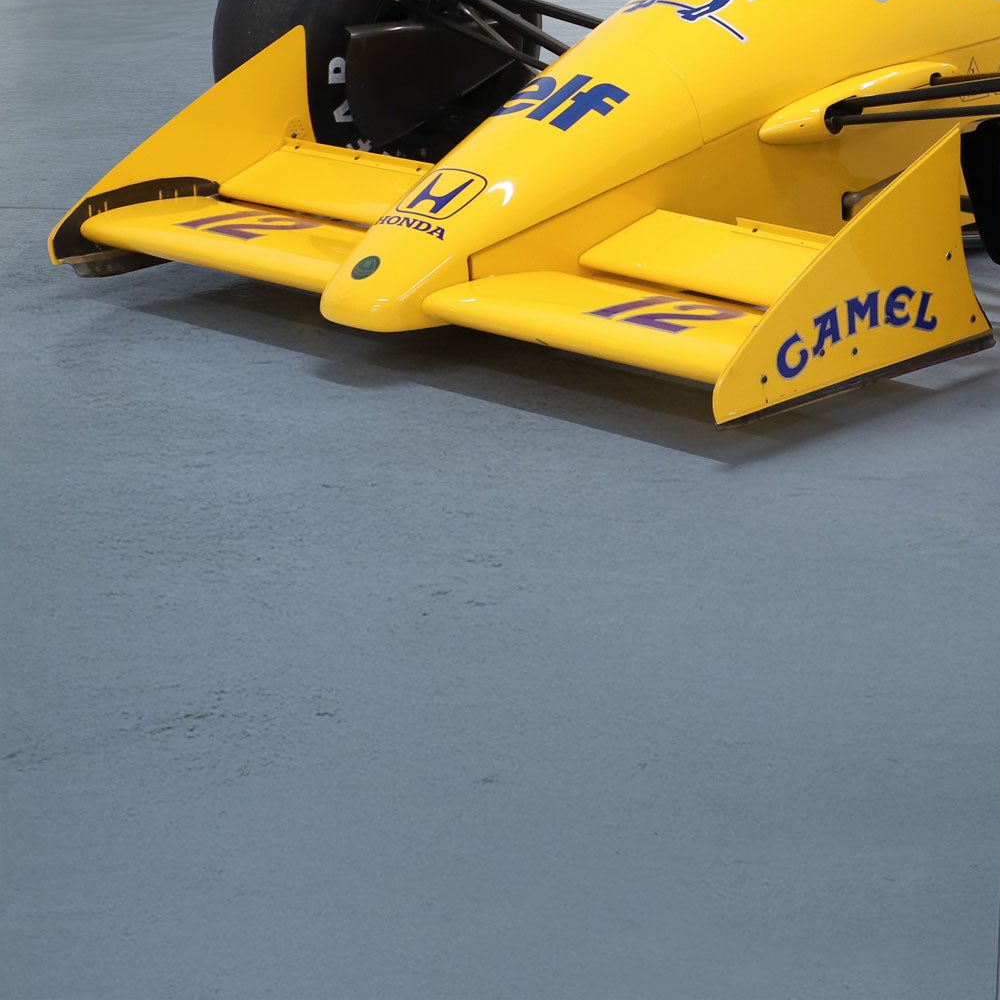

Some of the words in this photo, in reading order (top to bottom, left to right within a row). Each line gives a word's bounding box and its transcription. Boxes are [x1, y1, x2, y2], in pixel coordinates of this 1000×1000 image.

[489, 74, 630, 131] elf
[172, 209, 322, 241] 12
[378, 215, 445, 241] HONDA
[582, 295, 739, 334] 12
[775, 286, 938, 379] CAMEL
